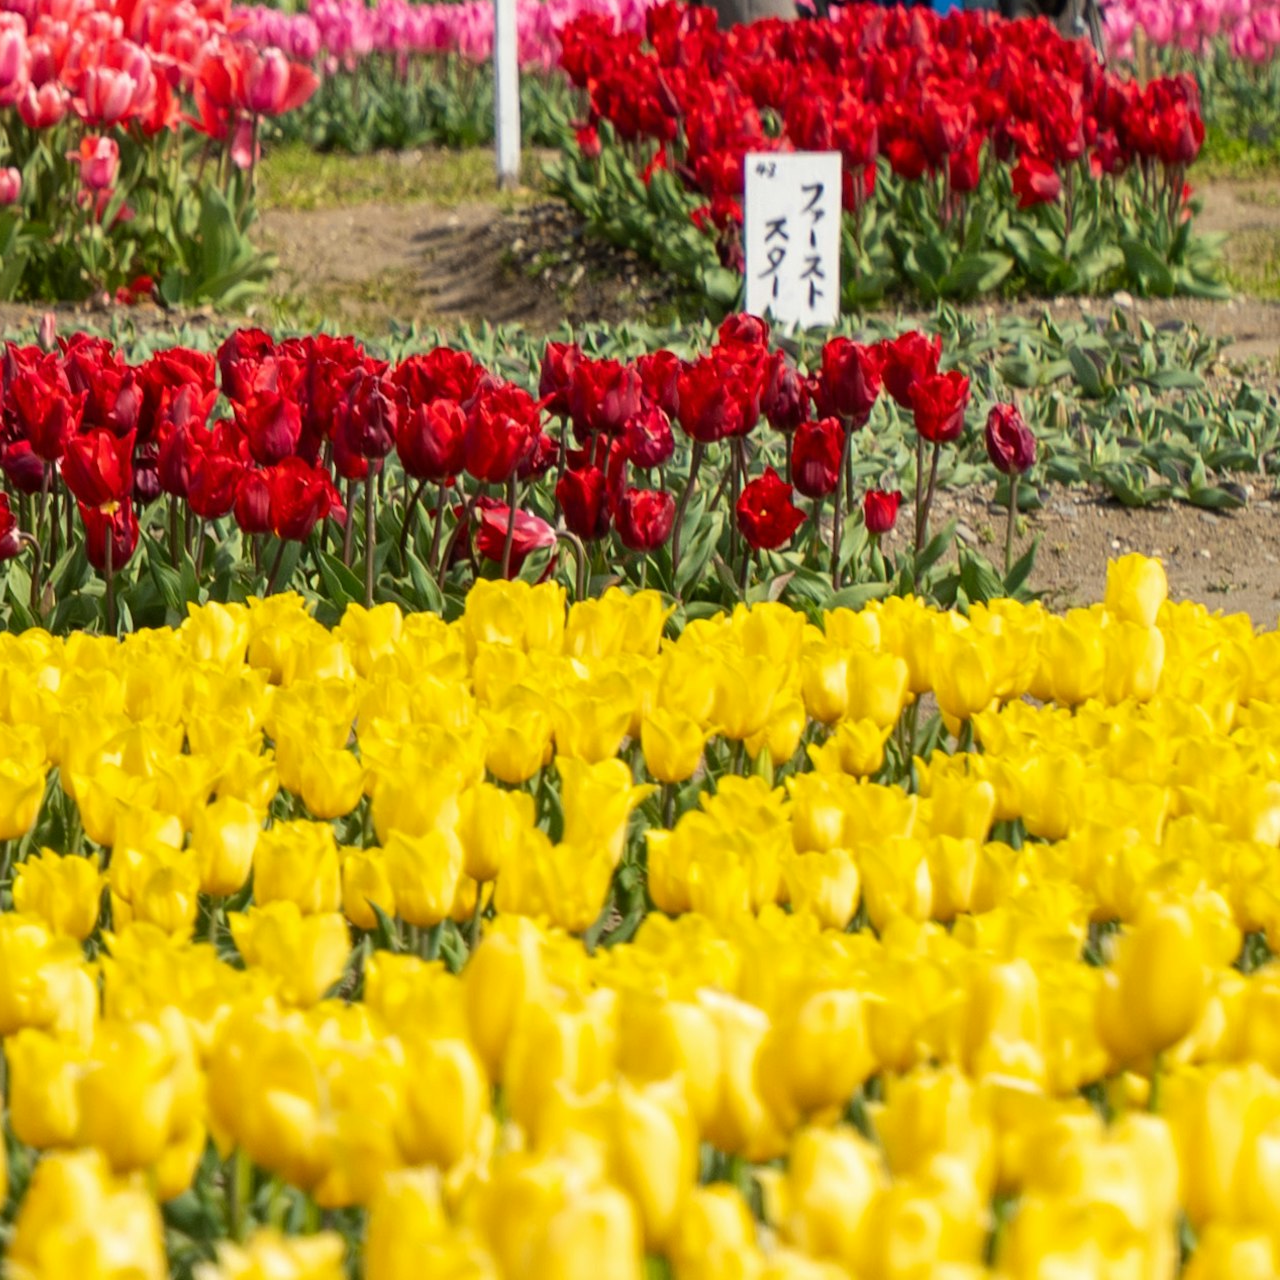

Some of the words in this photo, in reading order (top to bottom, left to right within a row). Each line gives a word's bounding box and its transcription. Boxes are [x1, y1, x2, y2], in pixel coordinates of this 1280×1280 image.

[758, 216, 790, 299] スター
[799, 182, 825, 310] ファースト
